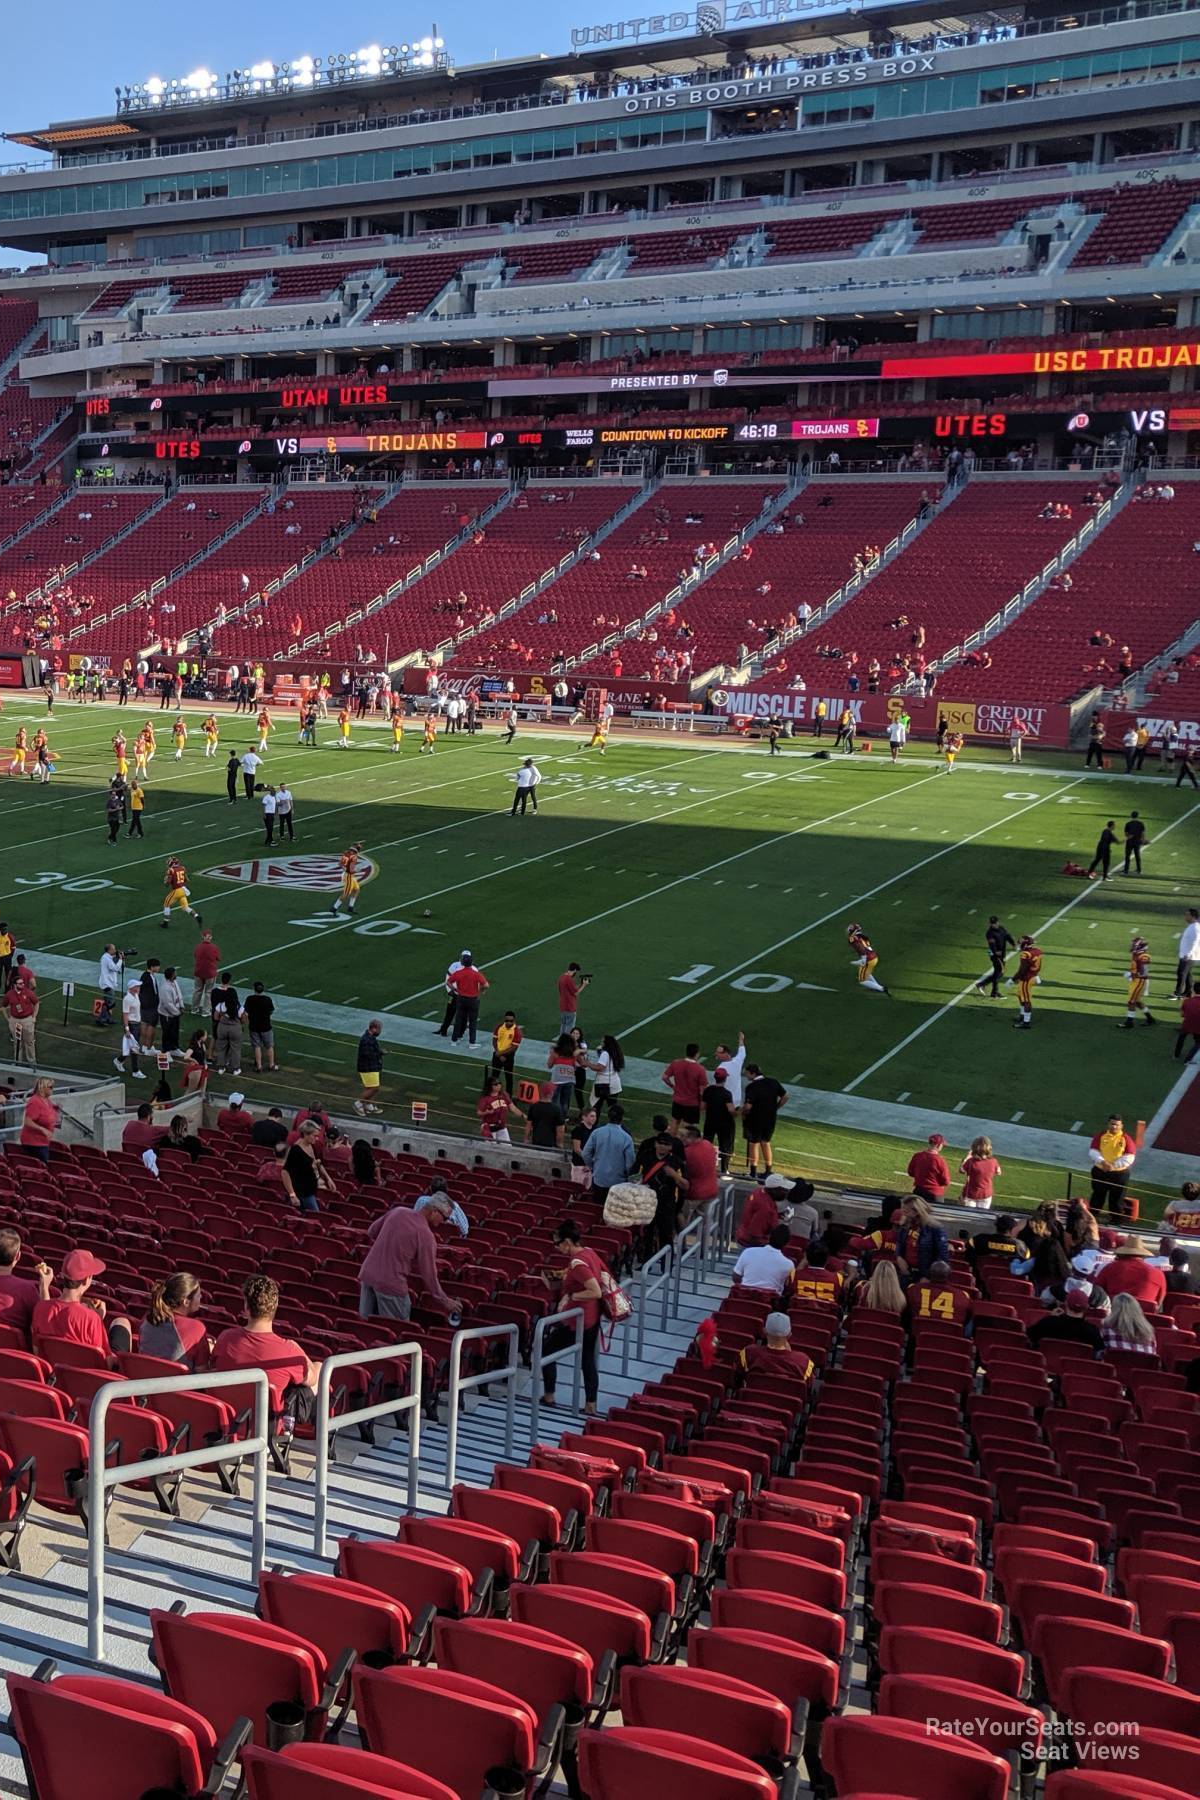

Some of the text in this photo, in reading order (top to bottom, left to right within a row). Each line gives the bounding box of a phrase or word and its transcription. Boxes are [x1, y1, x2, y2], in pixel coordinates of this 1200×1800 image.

[571, 11, 689, 47] UNITED
[624, 56, 936, 113] OTIS BOOTH PRESS BOX
[1034, 343, 1200, 373] USC TROJA
[610, 373, 698, 389] PRESENTED BY
[281, 385, 388, 408] UTAH UTES
[85, 398, 110, 417] UTES
[935, 414, 1006, 437] UTES
[1130, 409, 1166, 431] VS
[517, 432, 542, 444] UTES
[565, 429, 595, 438] WELLS
[601, 424, 778, 442] COUNTDOWN TO KICKOFF 46:18
[800, 424, 850, 436] TROJANS
[155, 440, 201, 459] UTES
[276, 438, 299, 455] VS
[366, 433, 458, 452] TROJANS
[565, 437, 594, 446] FARGO
[726, 691, 806, 719] MUSCLE
[976, 704, 1047, 723] CREDIT
[13, 871, 114, 893] 30
[175, 871, 186, 882] 15
[287, 910, 413, 937] 20
[668, 963, 794, 995] 10
[518, 1082, 535, 1100] 10
[796, 1279, 836, 1302] 55
[918, 1287, 955, 1320] 14
